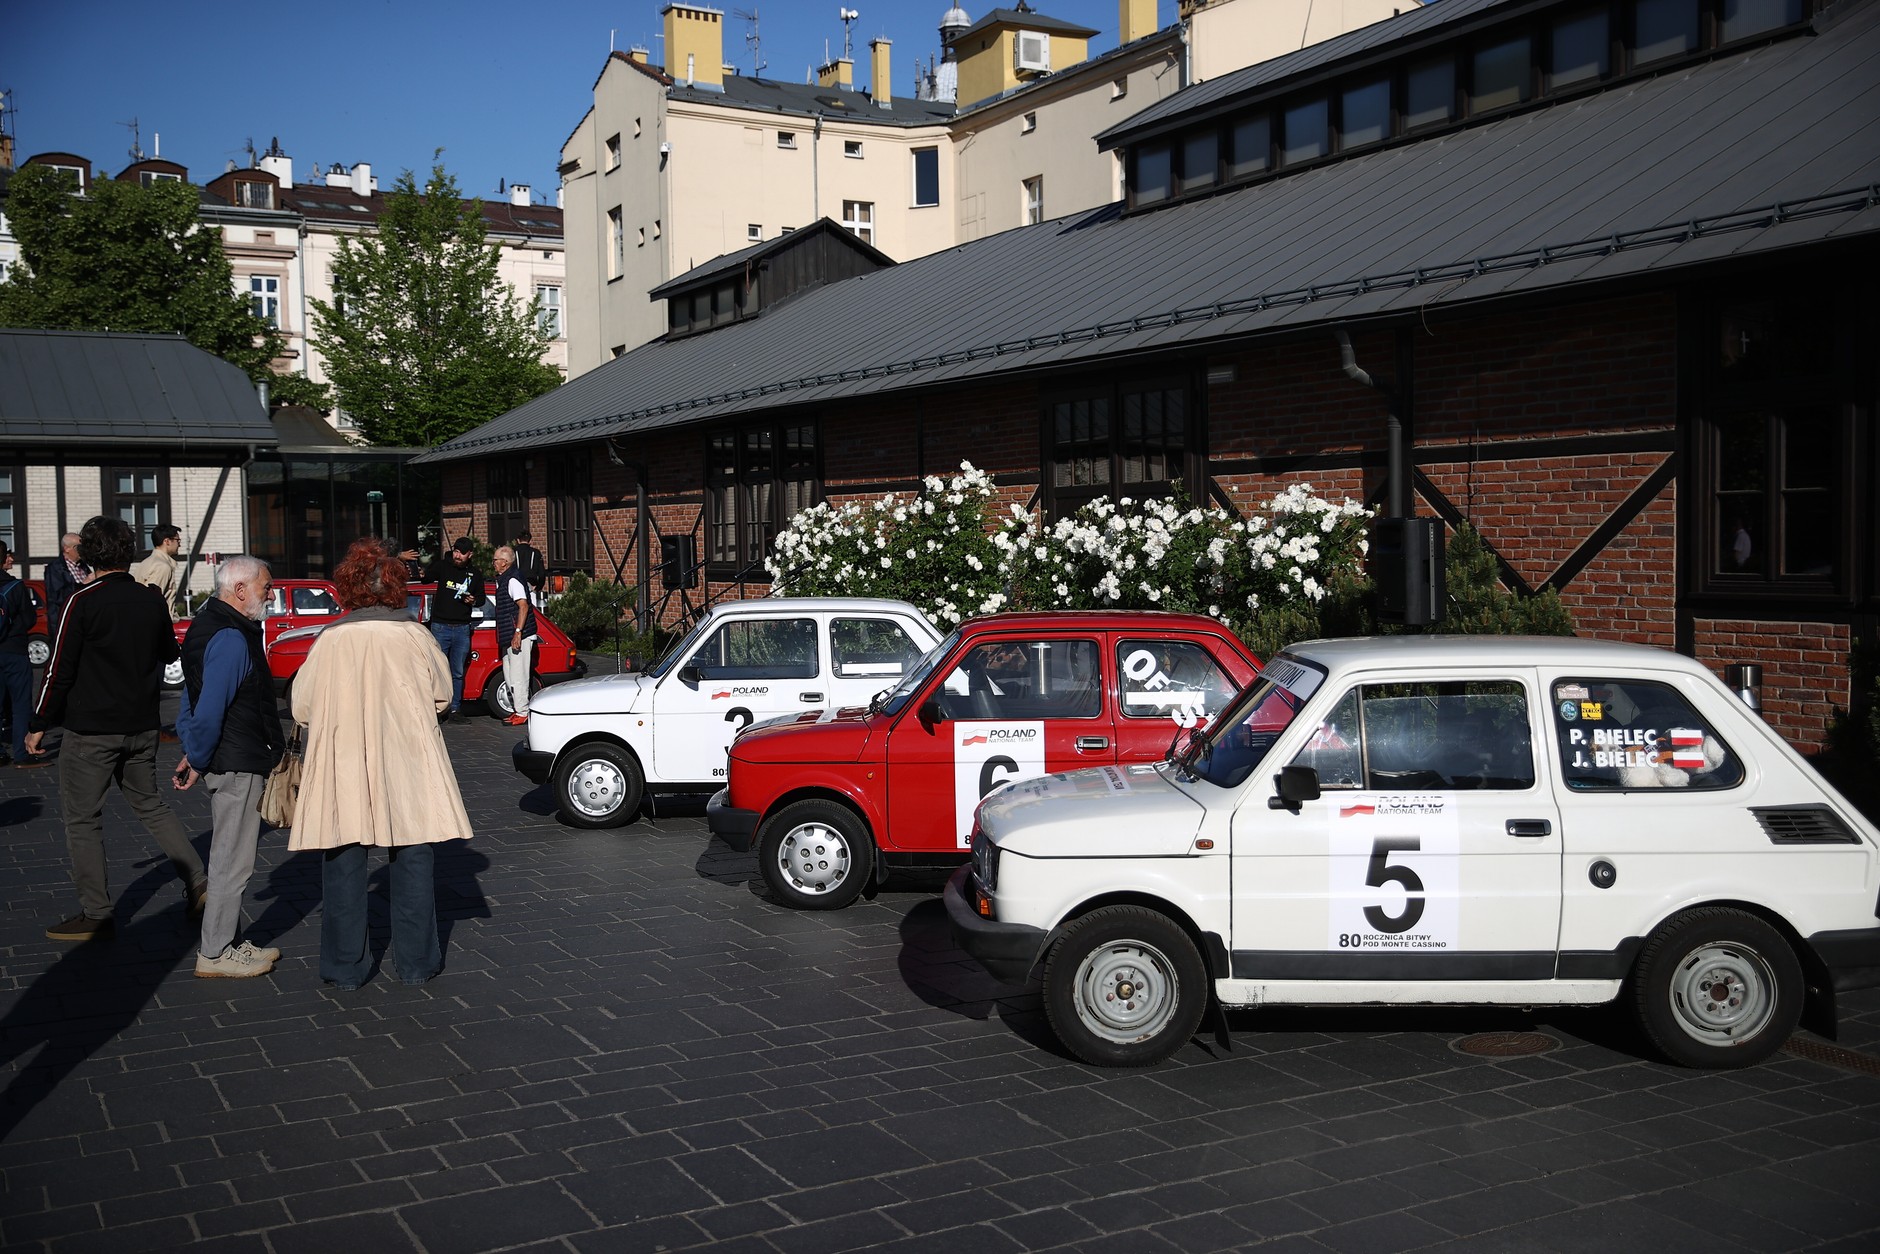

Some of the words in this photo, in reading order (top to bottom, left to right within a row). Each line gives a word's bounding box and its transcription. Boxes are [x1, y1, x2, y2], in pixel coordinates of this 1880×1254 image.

[732, 686, 769, 694] POLAND
[989, 729, 1037, 739] POLAND
[1569, 728, 1587, 745] P.
[1593, 728, 1657, 746] BIELEC
[1571, 751, 1588, 768] J.
[1595, 750, 1659, 768] BIELEC
[712, 768, 725, 777] 80
[1362, 834, 1426, 934] 5
[1338, 933, 1361, 948] 80
